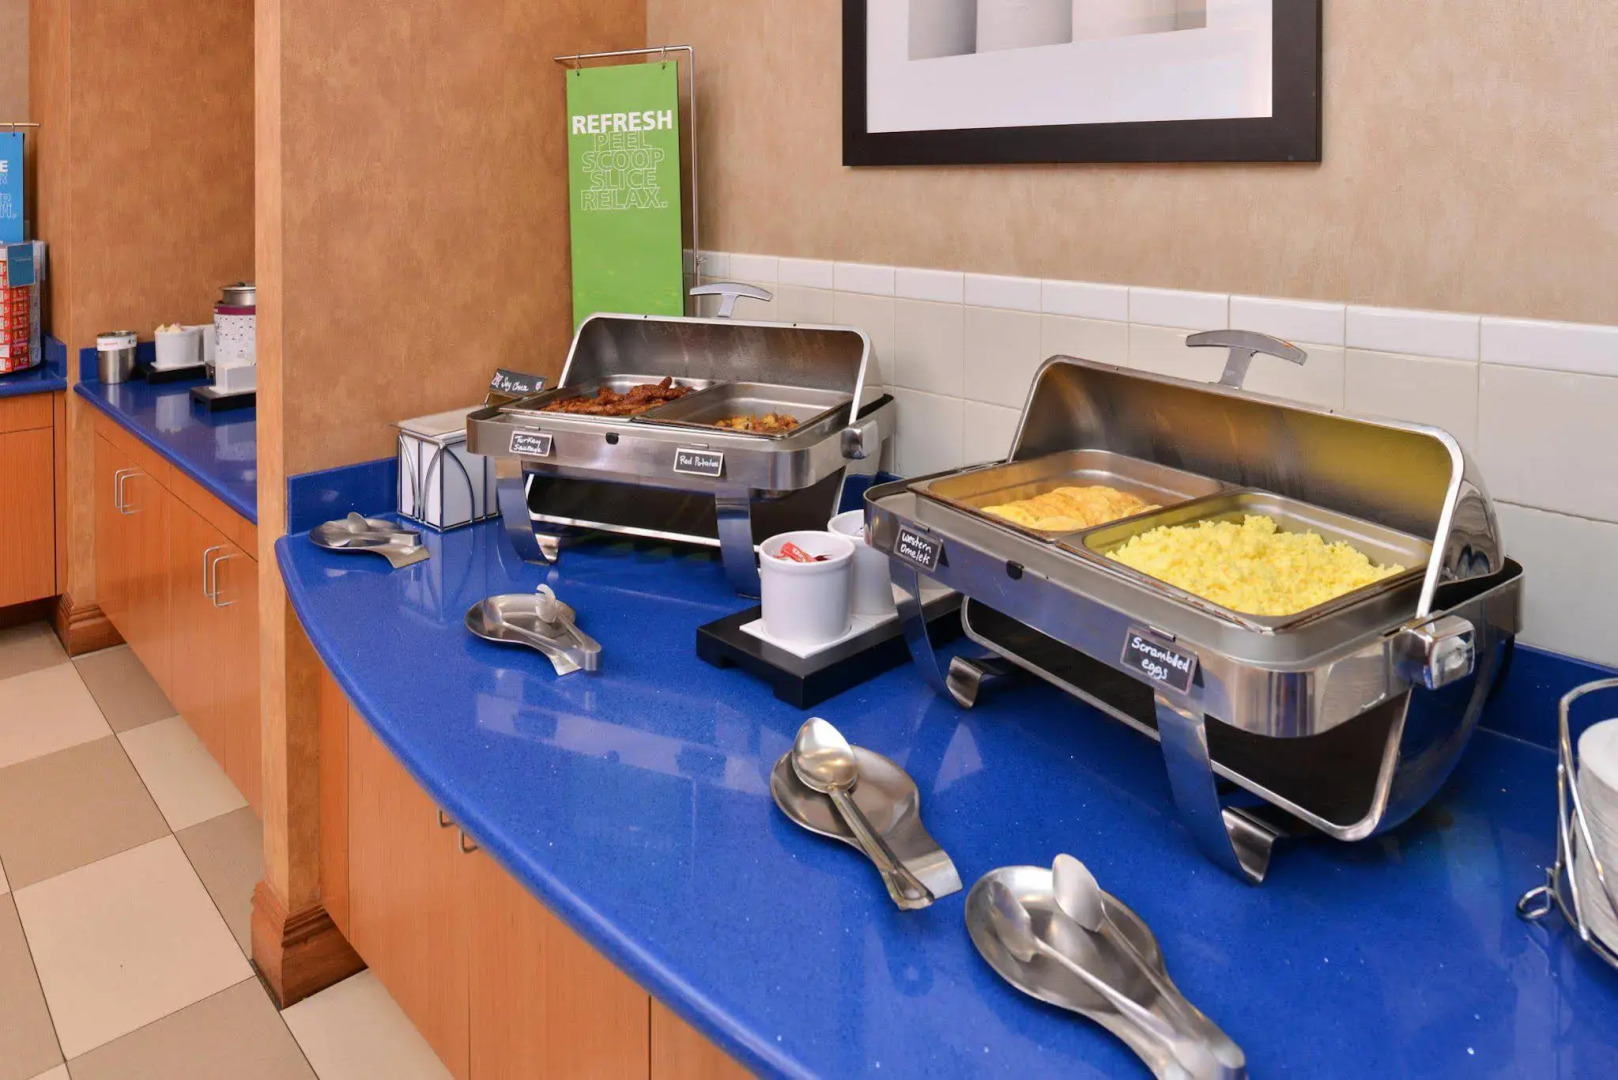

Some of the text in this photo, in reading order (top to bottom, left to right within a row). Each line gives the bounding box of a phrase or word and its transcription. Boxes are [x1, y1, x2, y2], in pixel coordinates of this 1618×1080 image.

[572, 109, 673, 135] REFRESH
[581, 147, 665, 172] SCOOP
[590, 168, 658, 192] SLICE
[581, 186, 668, 210] RELAX.
[1141, 658, 1169, 680] eggs
